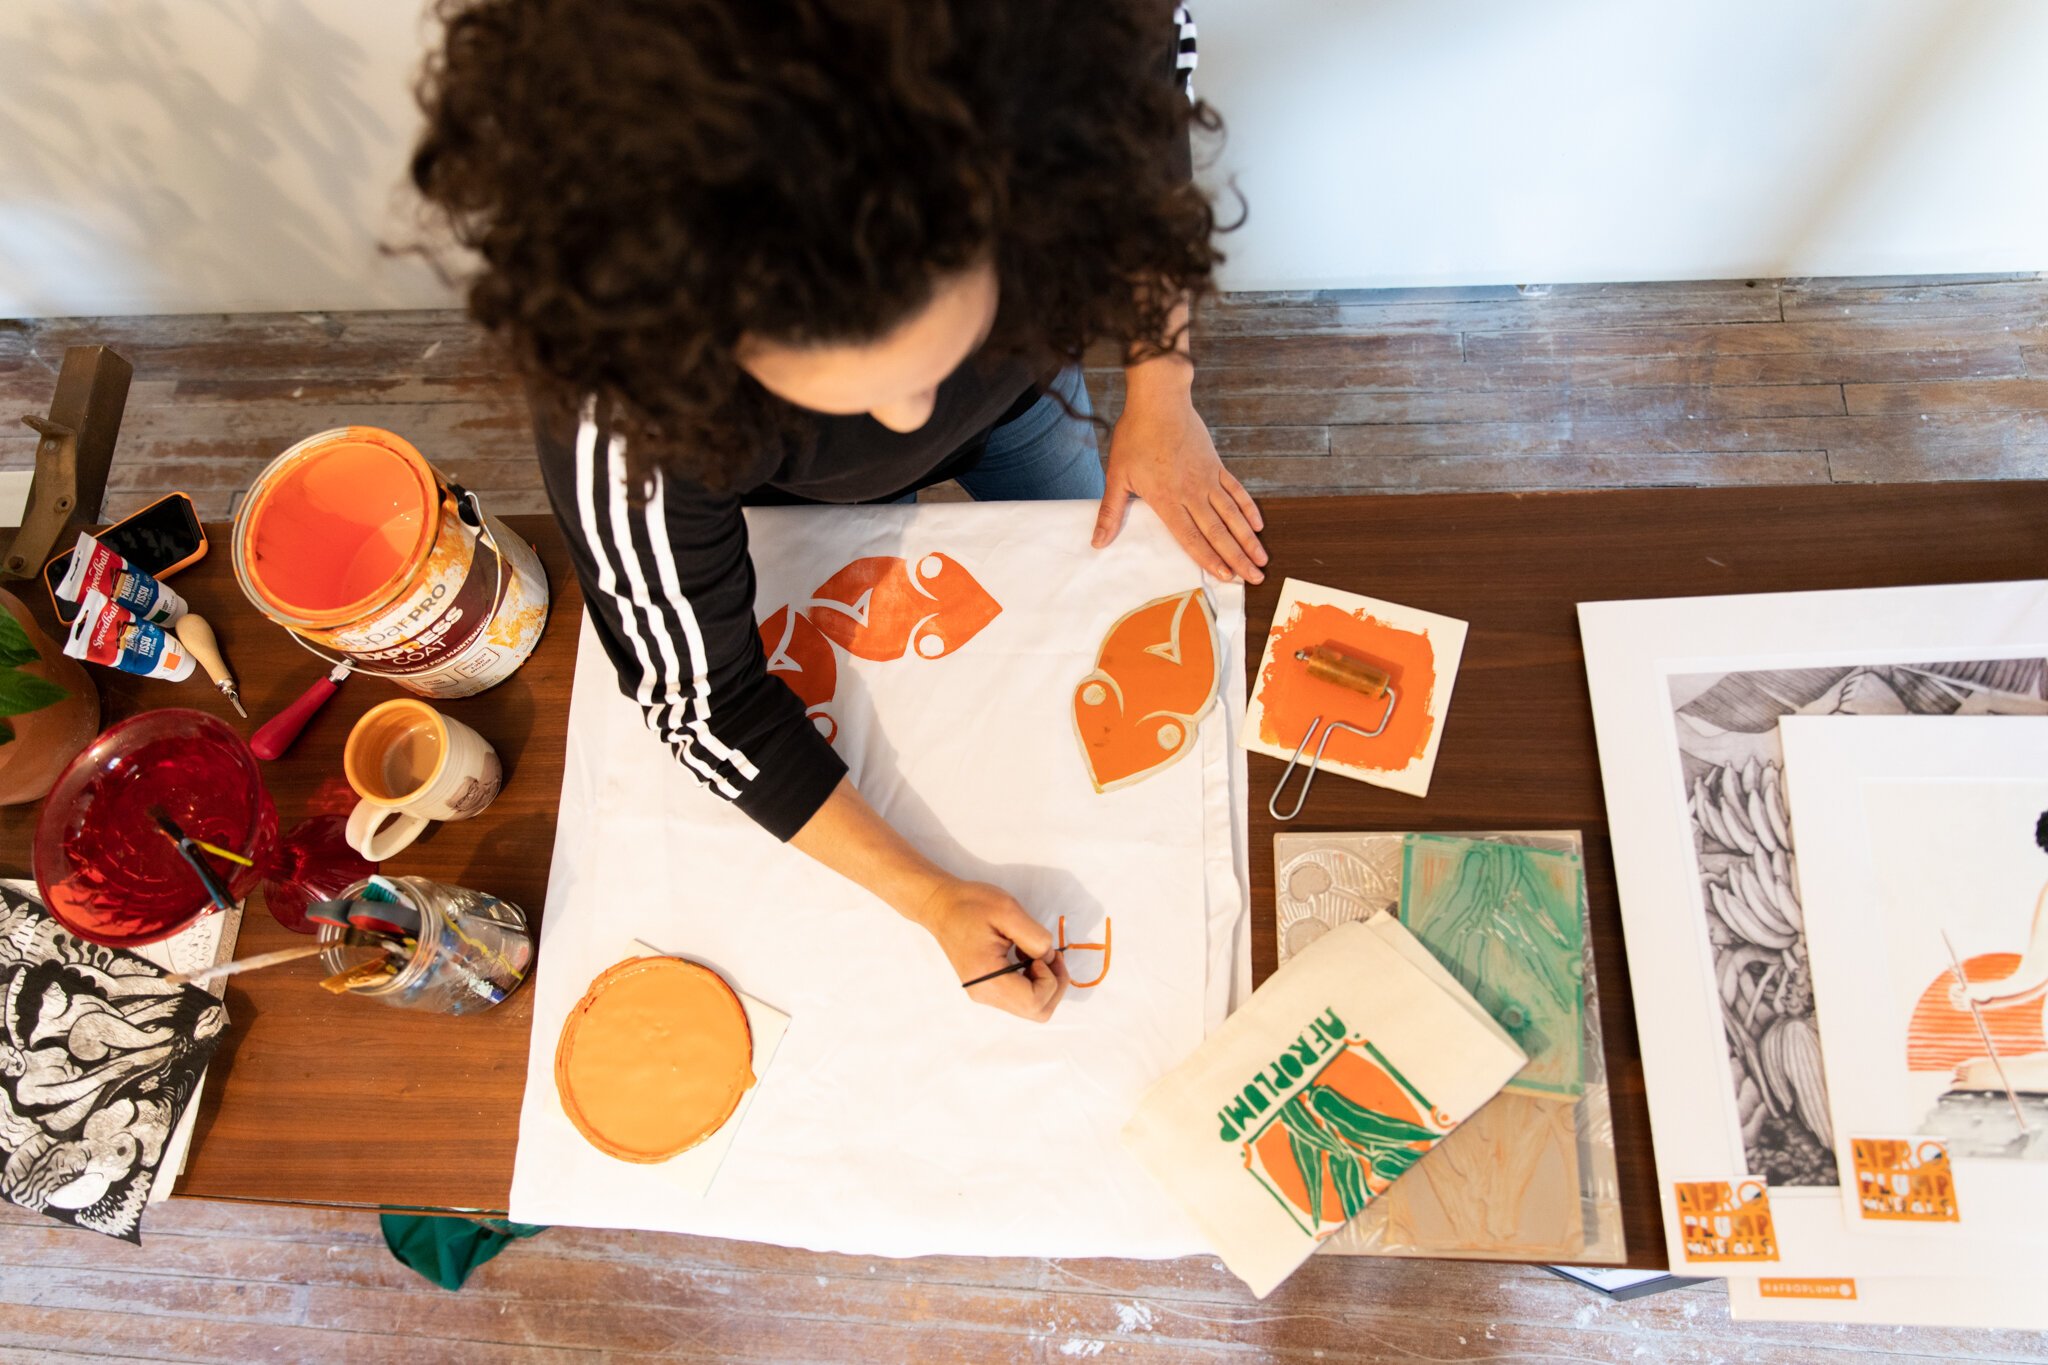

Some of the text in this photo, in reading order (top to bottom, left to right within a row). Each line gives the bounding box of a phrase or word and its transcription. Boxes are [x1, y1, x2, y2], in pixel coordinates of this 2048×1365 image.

[120, 574, 135, 600] FABRIC
[134, 585, 149, 606] TISSU
[93, 604, 120, 649] Speedball
[350, 606, 464, 661] EXPRESS
[138, 635, 152, 656] TISSU
[430, 656, 446, 666] FOR
[1217, 1006, 1346, 1142] AFROPLUMP
[1856, 1140, 1948, 1169] AFRO
[1677, 1181, 1767, 1212] AFRO
[1861, 1172, 1949, 1197] PLUMP
[1862, 1196, 1954, 1216] MURALS
[1684, 1215, 1769, 1238] PLUMP
[1686, 1238, 1775, 1257] MURALS
